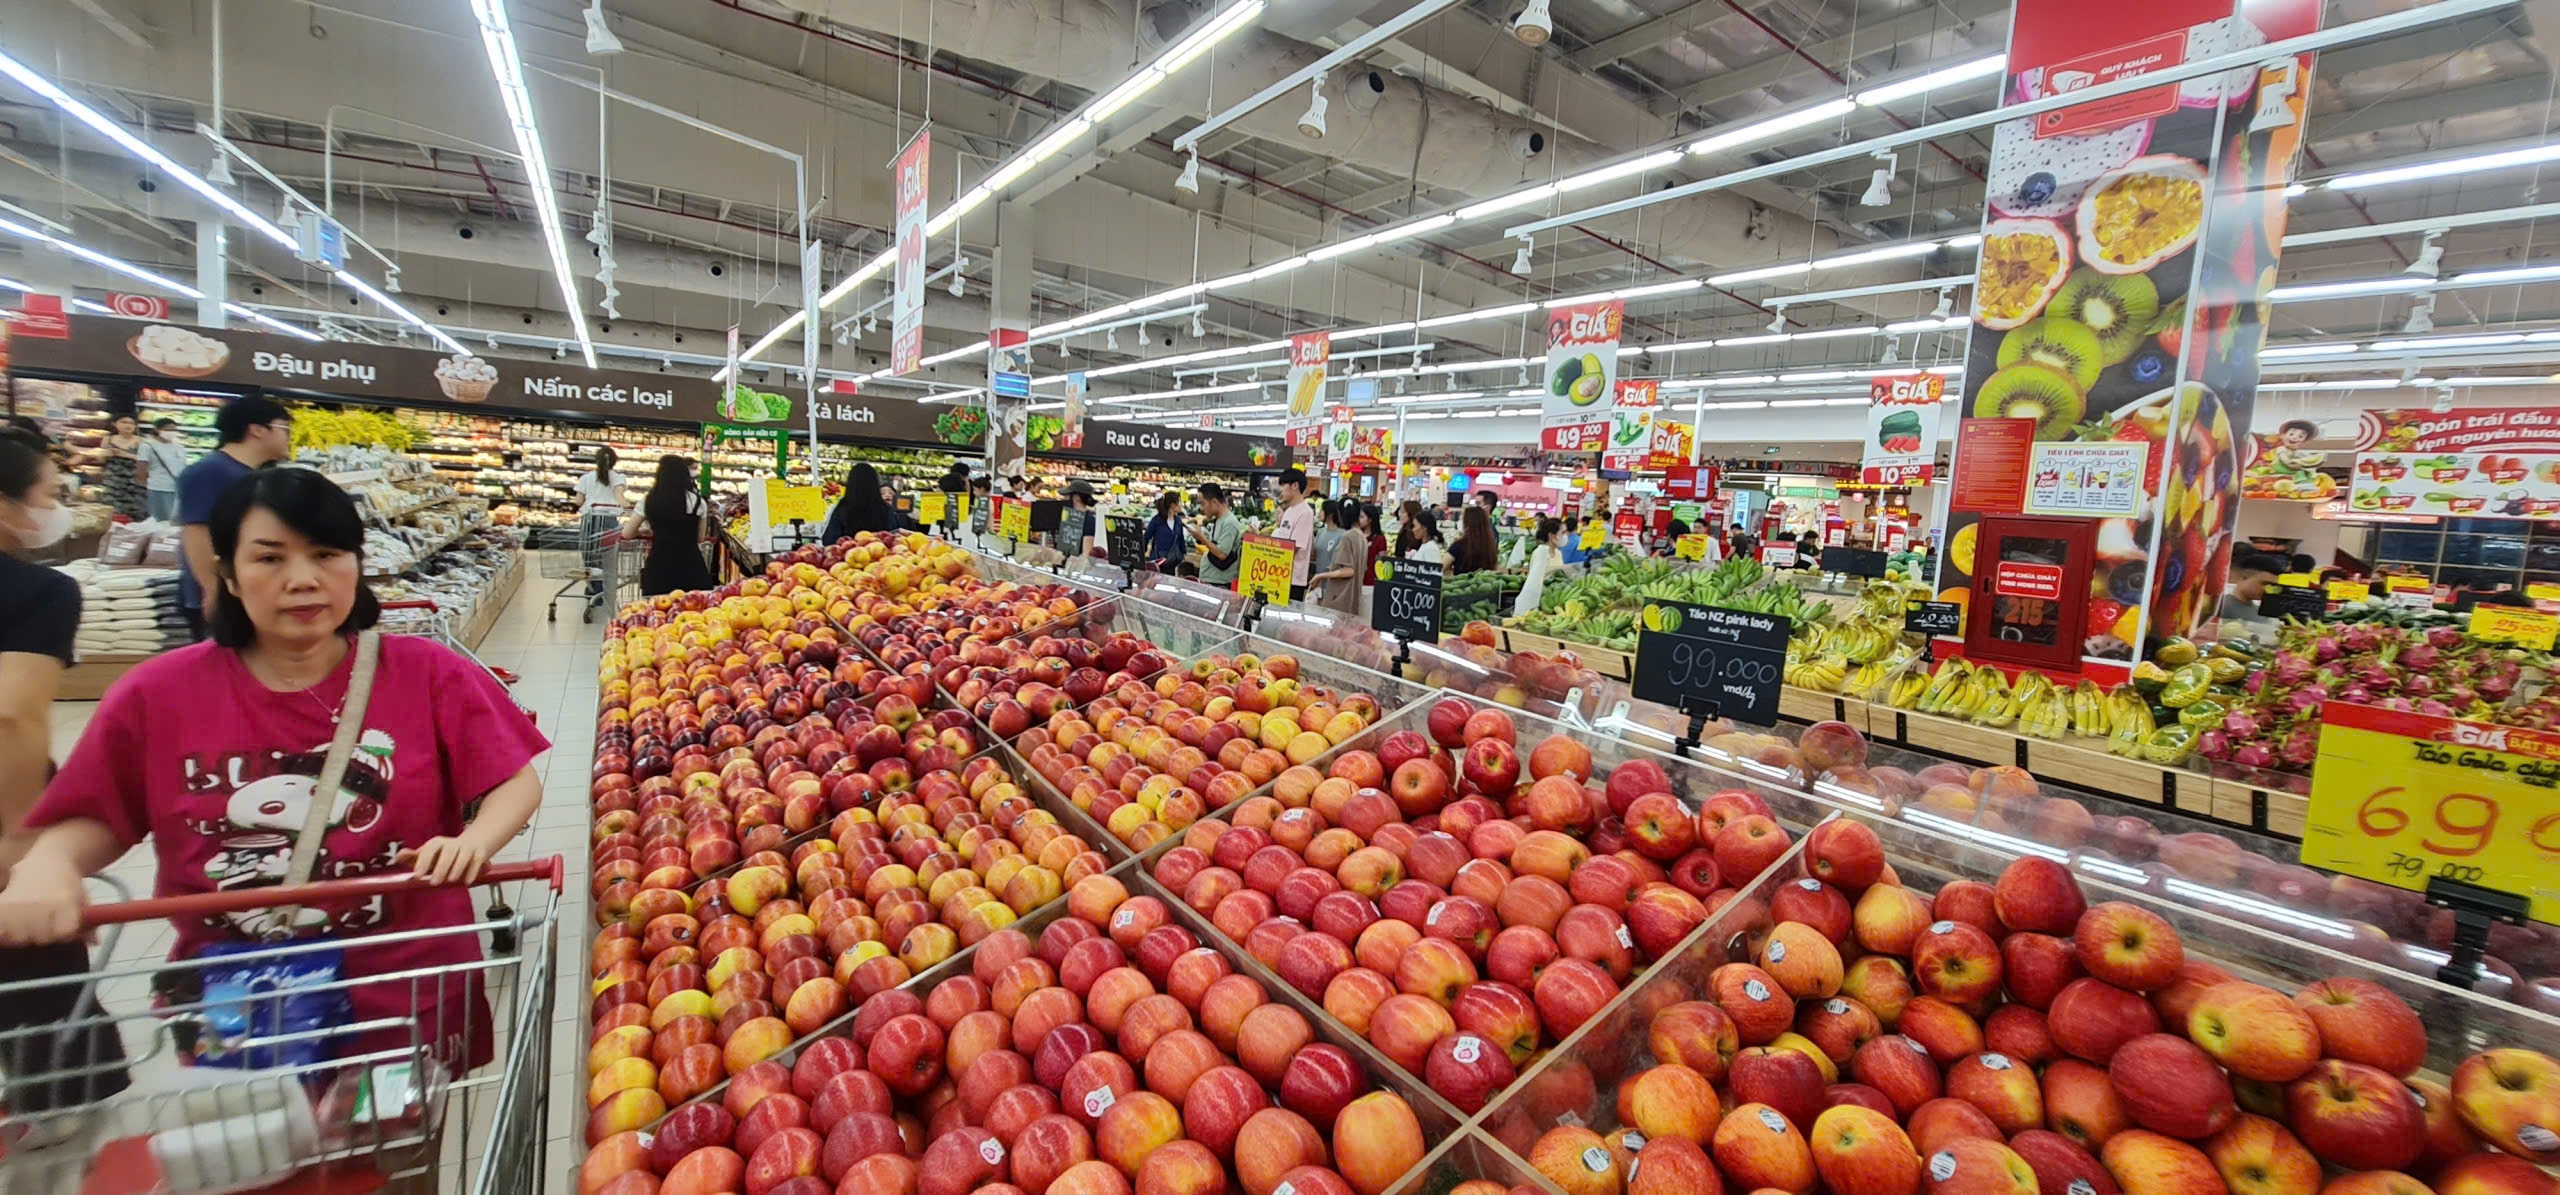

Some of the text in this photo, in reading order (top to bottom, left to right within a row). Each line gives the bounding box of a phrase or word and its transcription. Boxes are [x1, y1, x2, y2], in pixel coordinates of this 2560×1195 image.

[1570, 306, 1611, 339] GIÁ
[252, 351, 376, 385] Đậu phụ
[524, 376, 673, 410] Nấm các loại
[1892, 376, 1933, 400] GIÁ
[836, 402, 875, 424] lách
[2419, 418, 2462, 436] Đón
[2467, 412, 2505, 428] trái
[1106, 430, 1212, 453] Rau Củ sơ chế
[2416, 437, 2446, 452] Vẹn
[2450, 428, 2517, 445] nguyên
[1688, 608, 1774, 632] Táo NZ pink lady
[1668, 643, 1777, 688] 99.000
[2413, 741, 2452, 764] Táo
